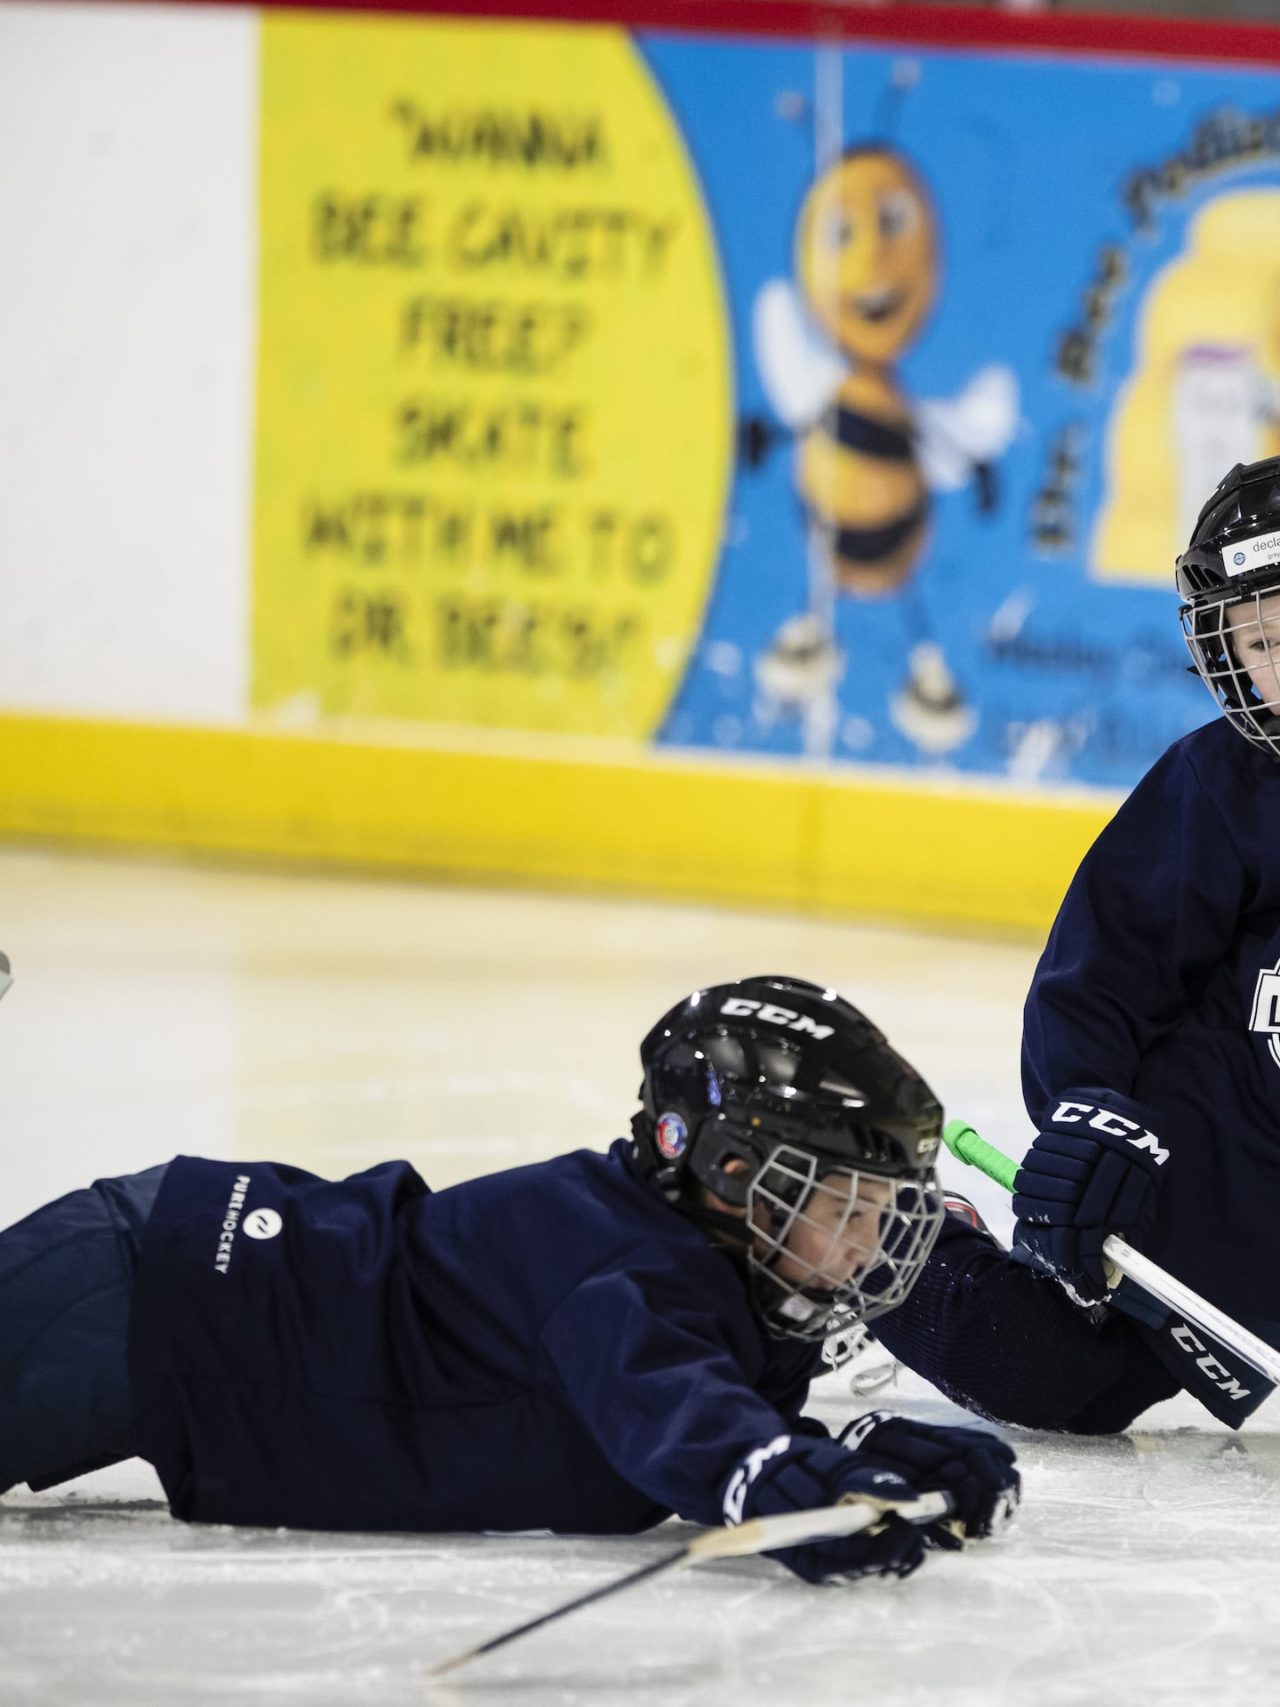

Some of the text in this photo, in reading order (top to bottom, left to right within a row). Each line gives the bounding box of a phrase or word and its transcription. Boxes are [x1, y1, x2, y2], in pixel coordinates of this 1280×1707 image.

[316, 195, 678, 276] BEE CAVITY
[407, 301, 587, 372] FREE?
[401, 404, 578, 474] SKATE
[307, 498, 672, 581] WITH ME TO
[720, 997, 835, 1041] CCM
[1051, 1101, 1170, 1167] CCM
[1170, 1322, 1252, 1401] CCM
[723, 1434, 792, 1529] CM
